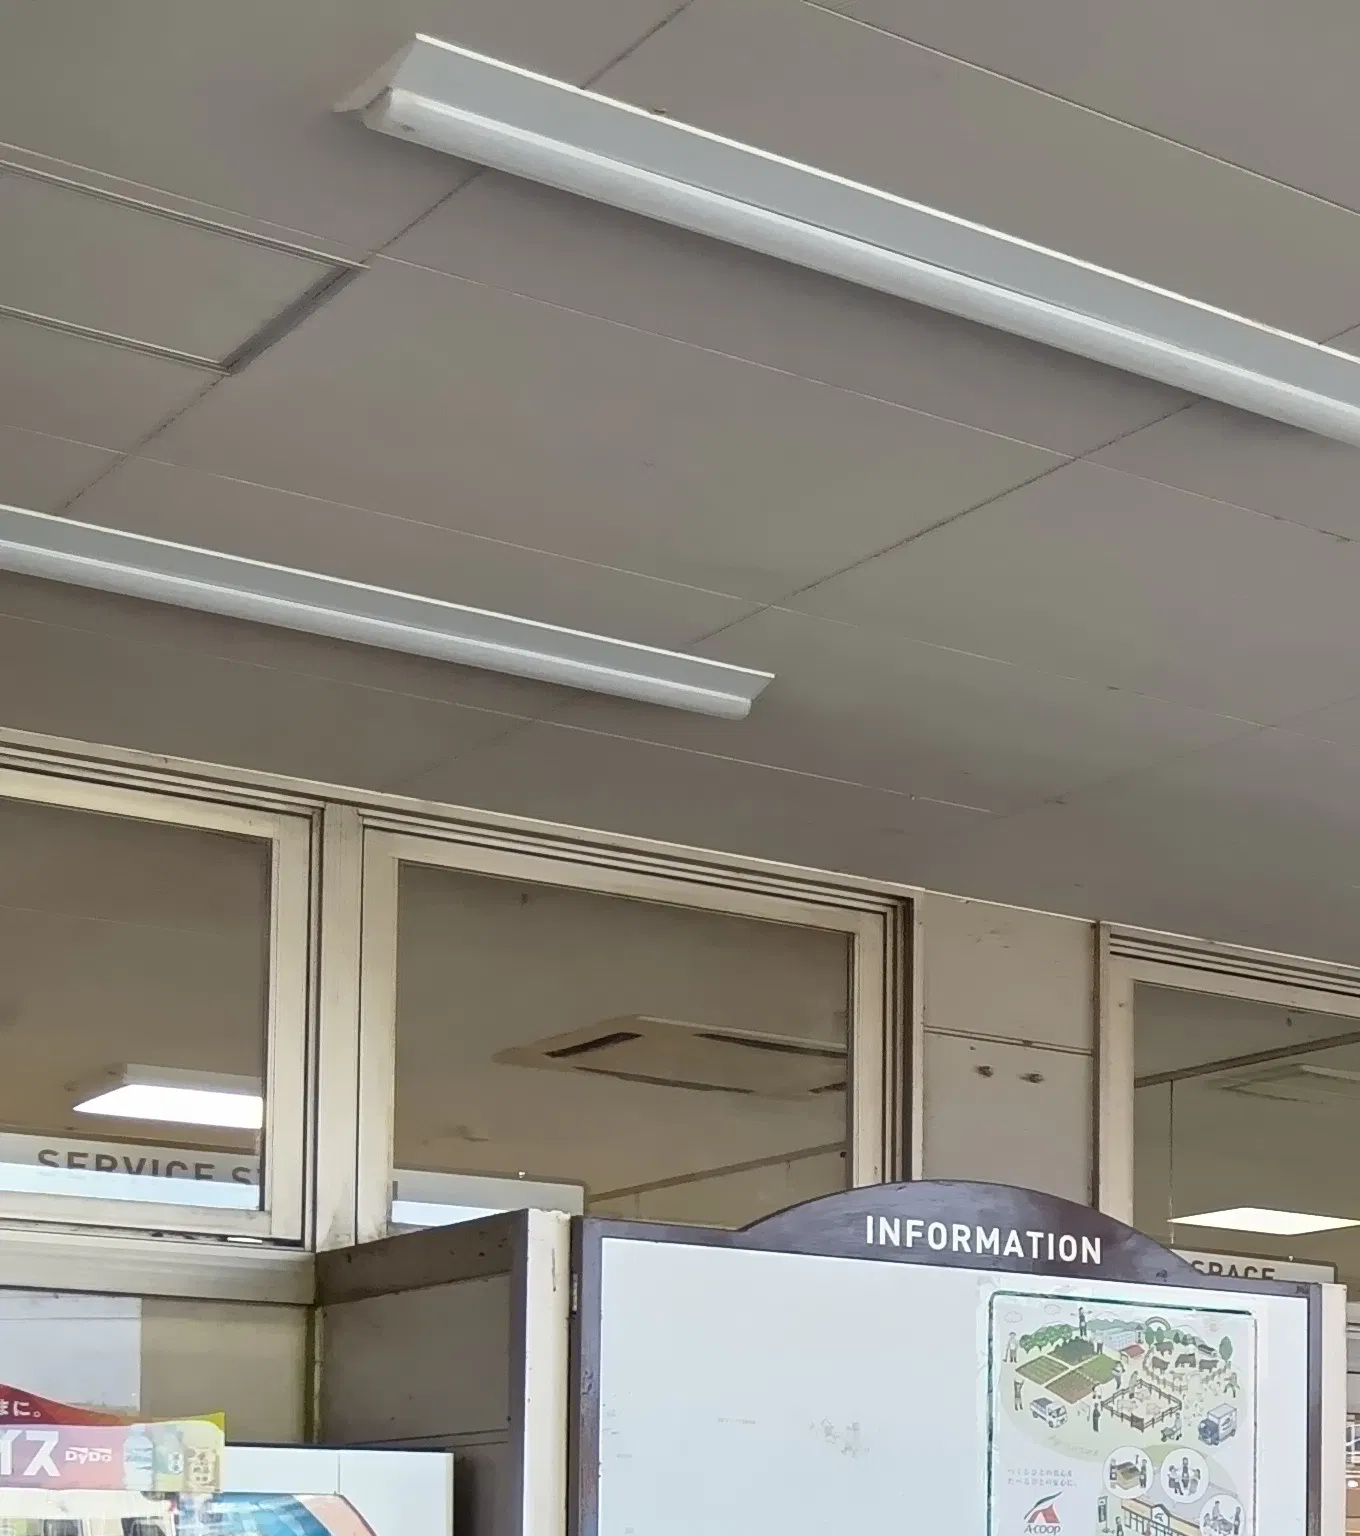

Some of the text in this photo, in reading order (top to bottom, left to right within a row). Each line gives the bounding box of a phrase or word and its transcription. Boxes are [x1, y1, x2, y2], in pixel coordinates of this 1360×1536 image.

[231, 1166, 260, 1184] S
[866, 1215, 1102, 1265] INFORMATION
[65, 1446, 112, 1464] DyDo
